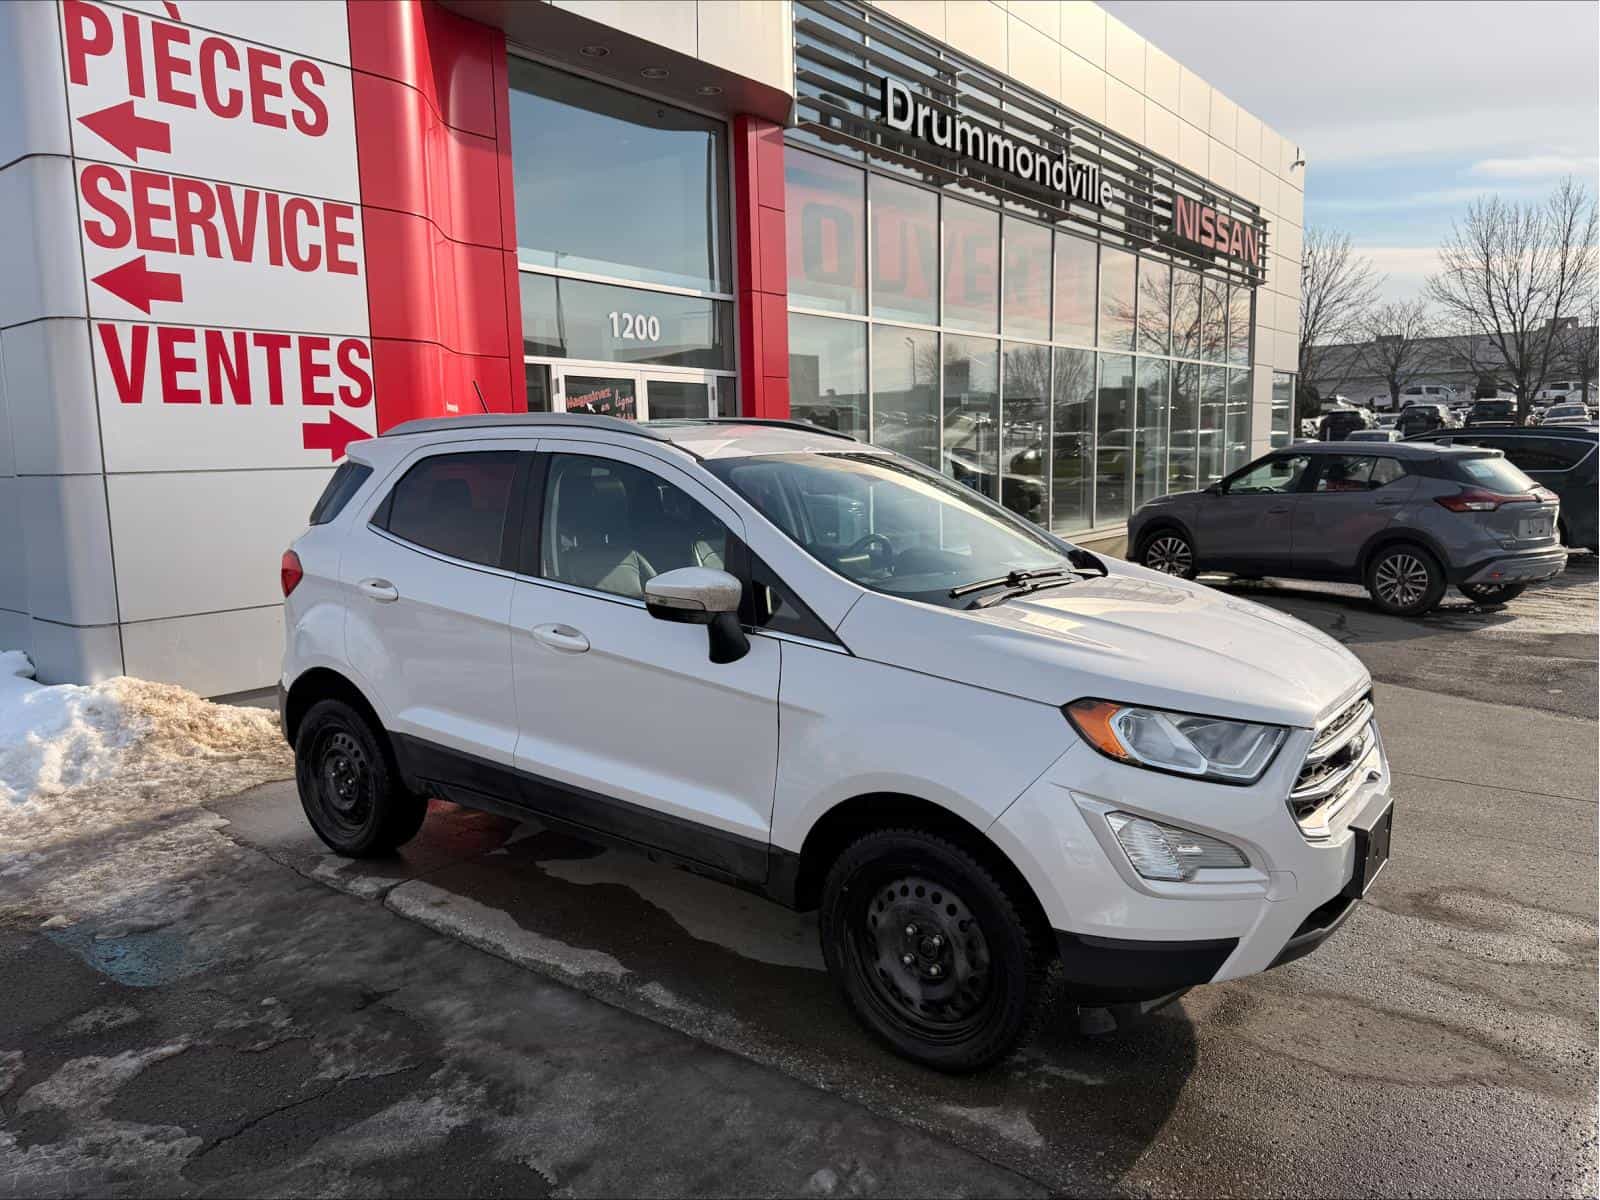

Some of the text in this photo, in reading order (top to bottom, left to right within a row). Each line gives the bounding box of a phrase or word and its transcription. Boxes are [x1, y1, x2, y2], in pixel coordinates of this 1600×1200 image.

[63, 0, 329, 137] PIÈCES
[884, 78, 1115, 209] Drummondville
[79, 164, 359, 275] SERVICE
[801, 201, 1096, 318] OUVER
[1175, 194, 1259, 265] NISSAN
[97, 323, 373, 408] VENTES
[608, 311, 661, 342] 1200
